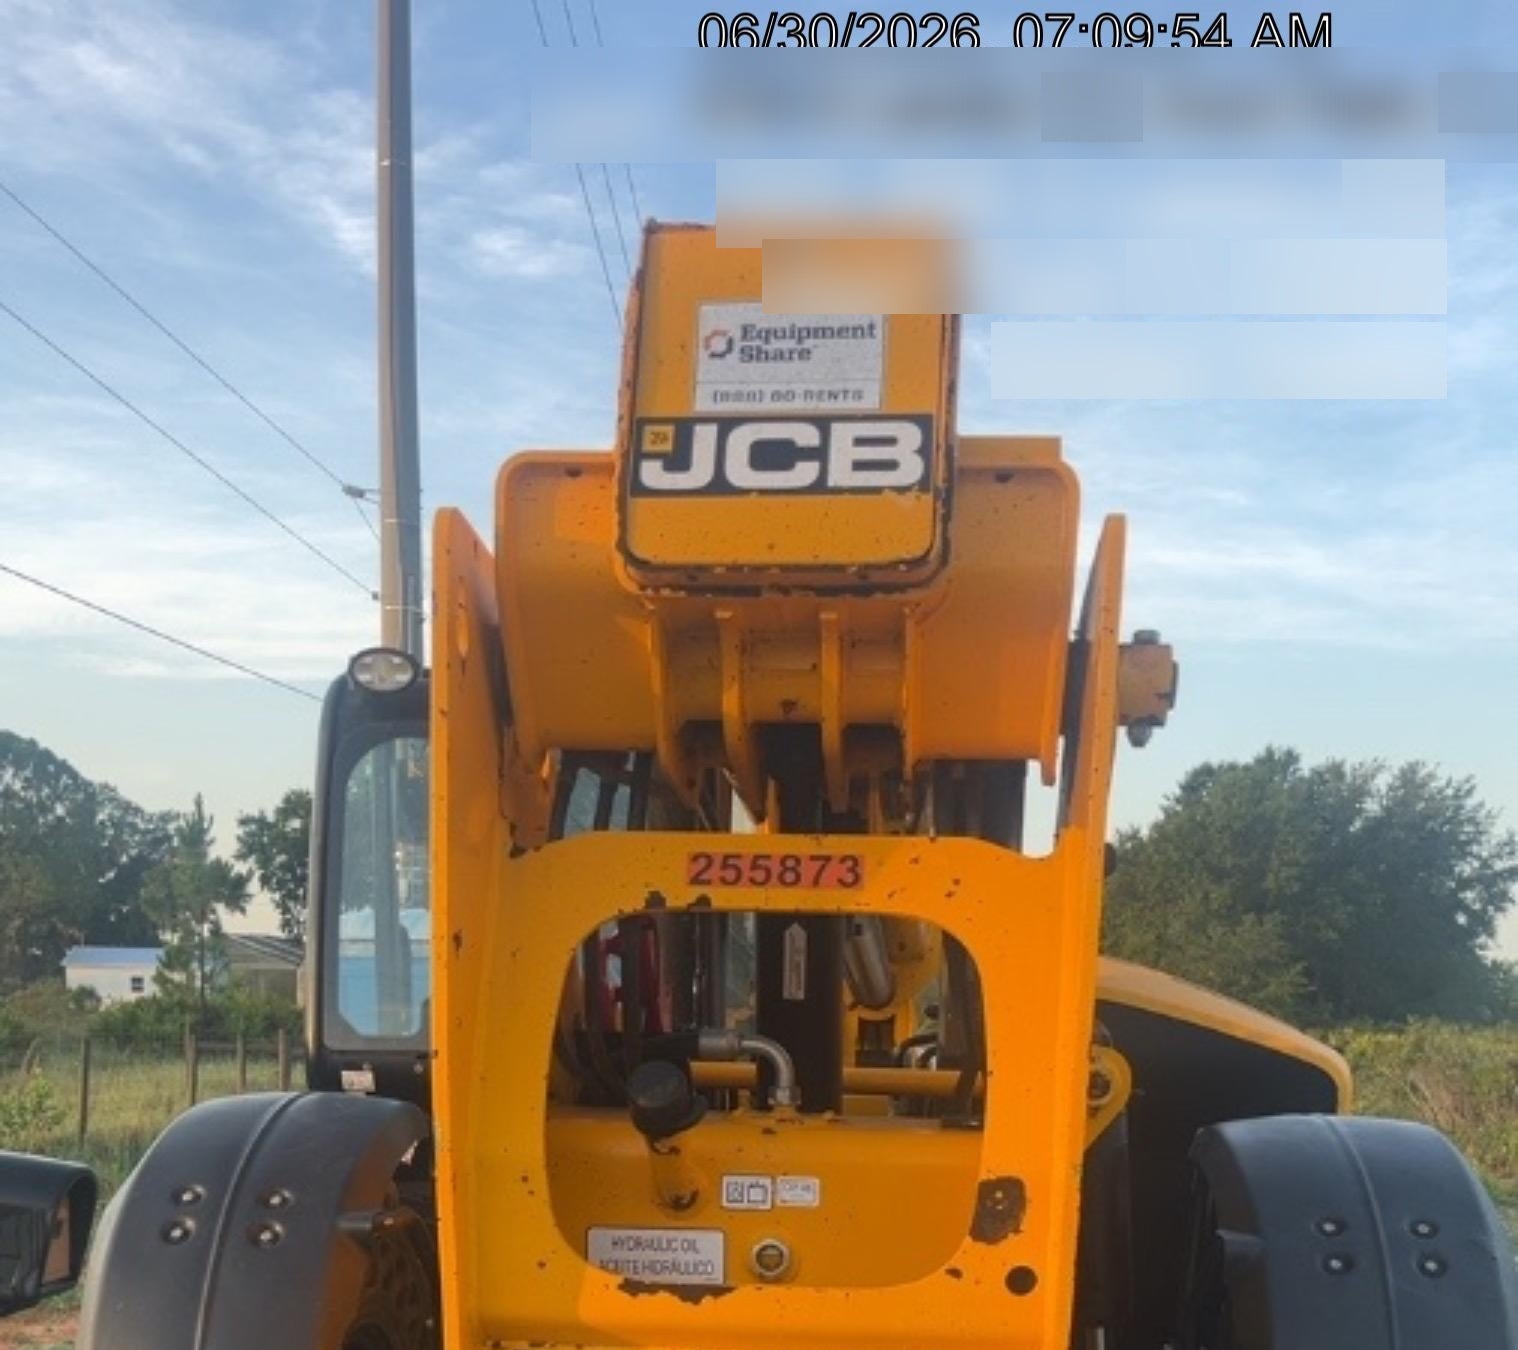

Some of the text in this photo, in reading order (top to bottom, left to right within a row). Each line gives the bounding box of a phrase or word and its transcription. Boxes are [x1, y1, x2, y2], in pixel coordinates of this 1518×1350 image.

[740, 321, 877, 345] Equipment
[739, 344, 812, 364] Share
[639, 421, 925, 491] JCB
[689, 851, 863, 888] 255873
[611, 1236, 700, 1254] HYDRAULIC OIL
